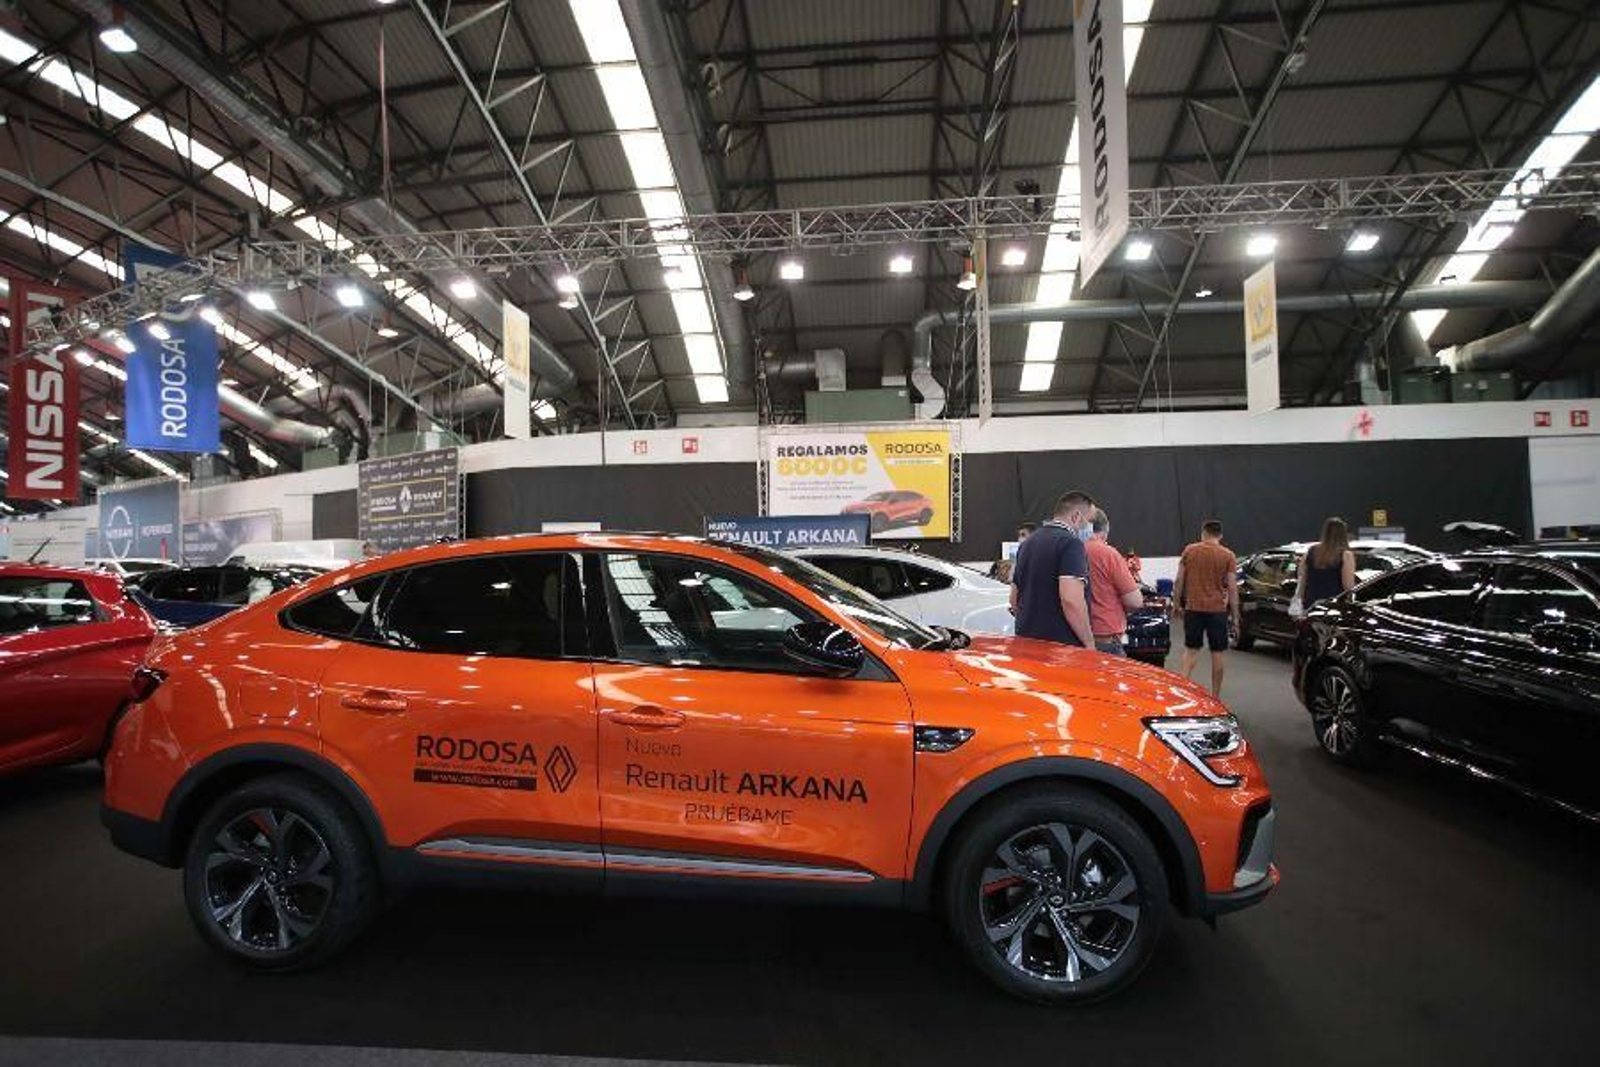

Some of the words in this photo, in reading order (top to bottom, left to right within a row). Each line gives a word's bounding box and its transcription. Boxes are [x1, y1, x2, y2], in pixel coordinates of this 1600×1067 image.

[162, 338, 187, 438] RODOSA
[777, 445, 868, 458] REGALAMOS
[884, 443, 943, 454] RODOSA
[786, 529, 858, 544] ARKANA
[416, 735, 537, 766] RODOSA
[625, 738, 682, 757] Nuevo
[625, 763, 729, 793] Renault
[737, 773, 868, 804] ARKANA
[684, 803, 794, 826] PRUÉBAME
